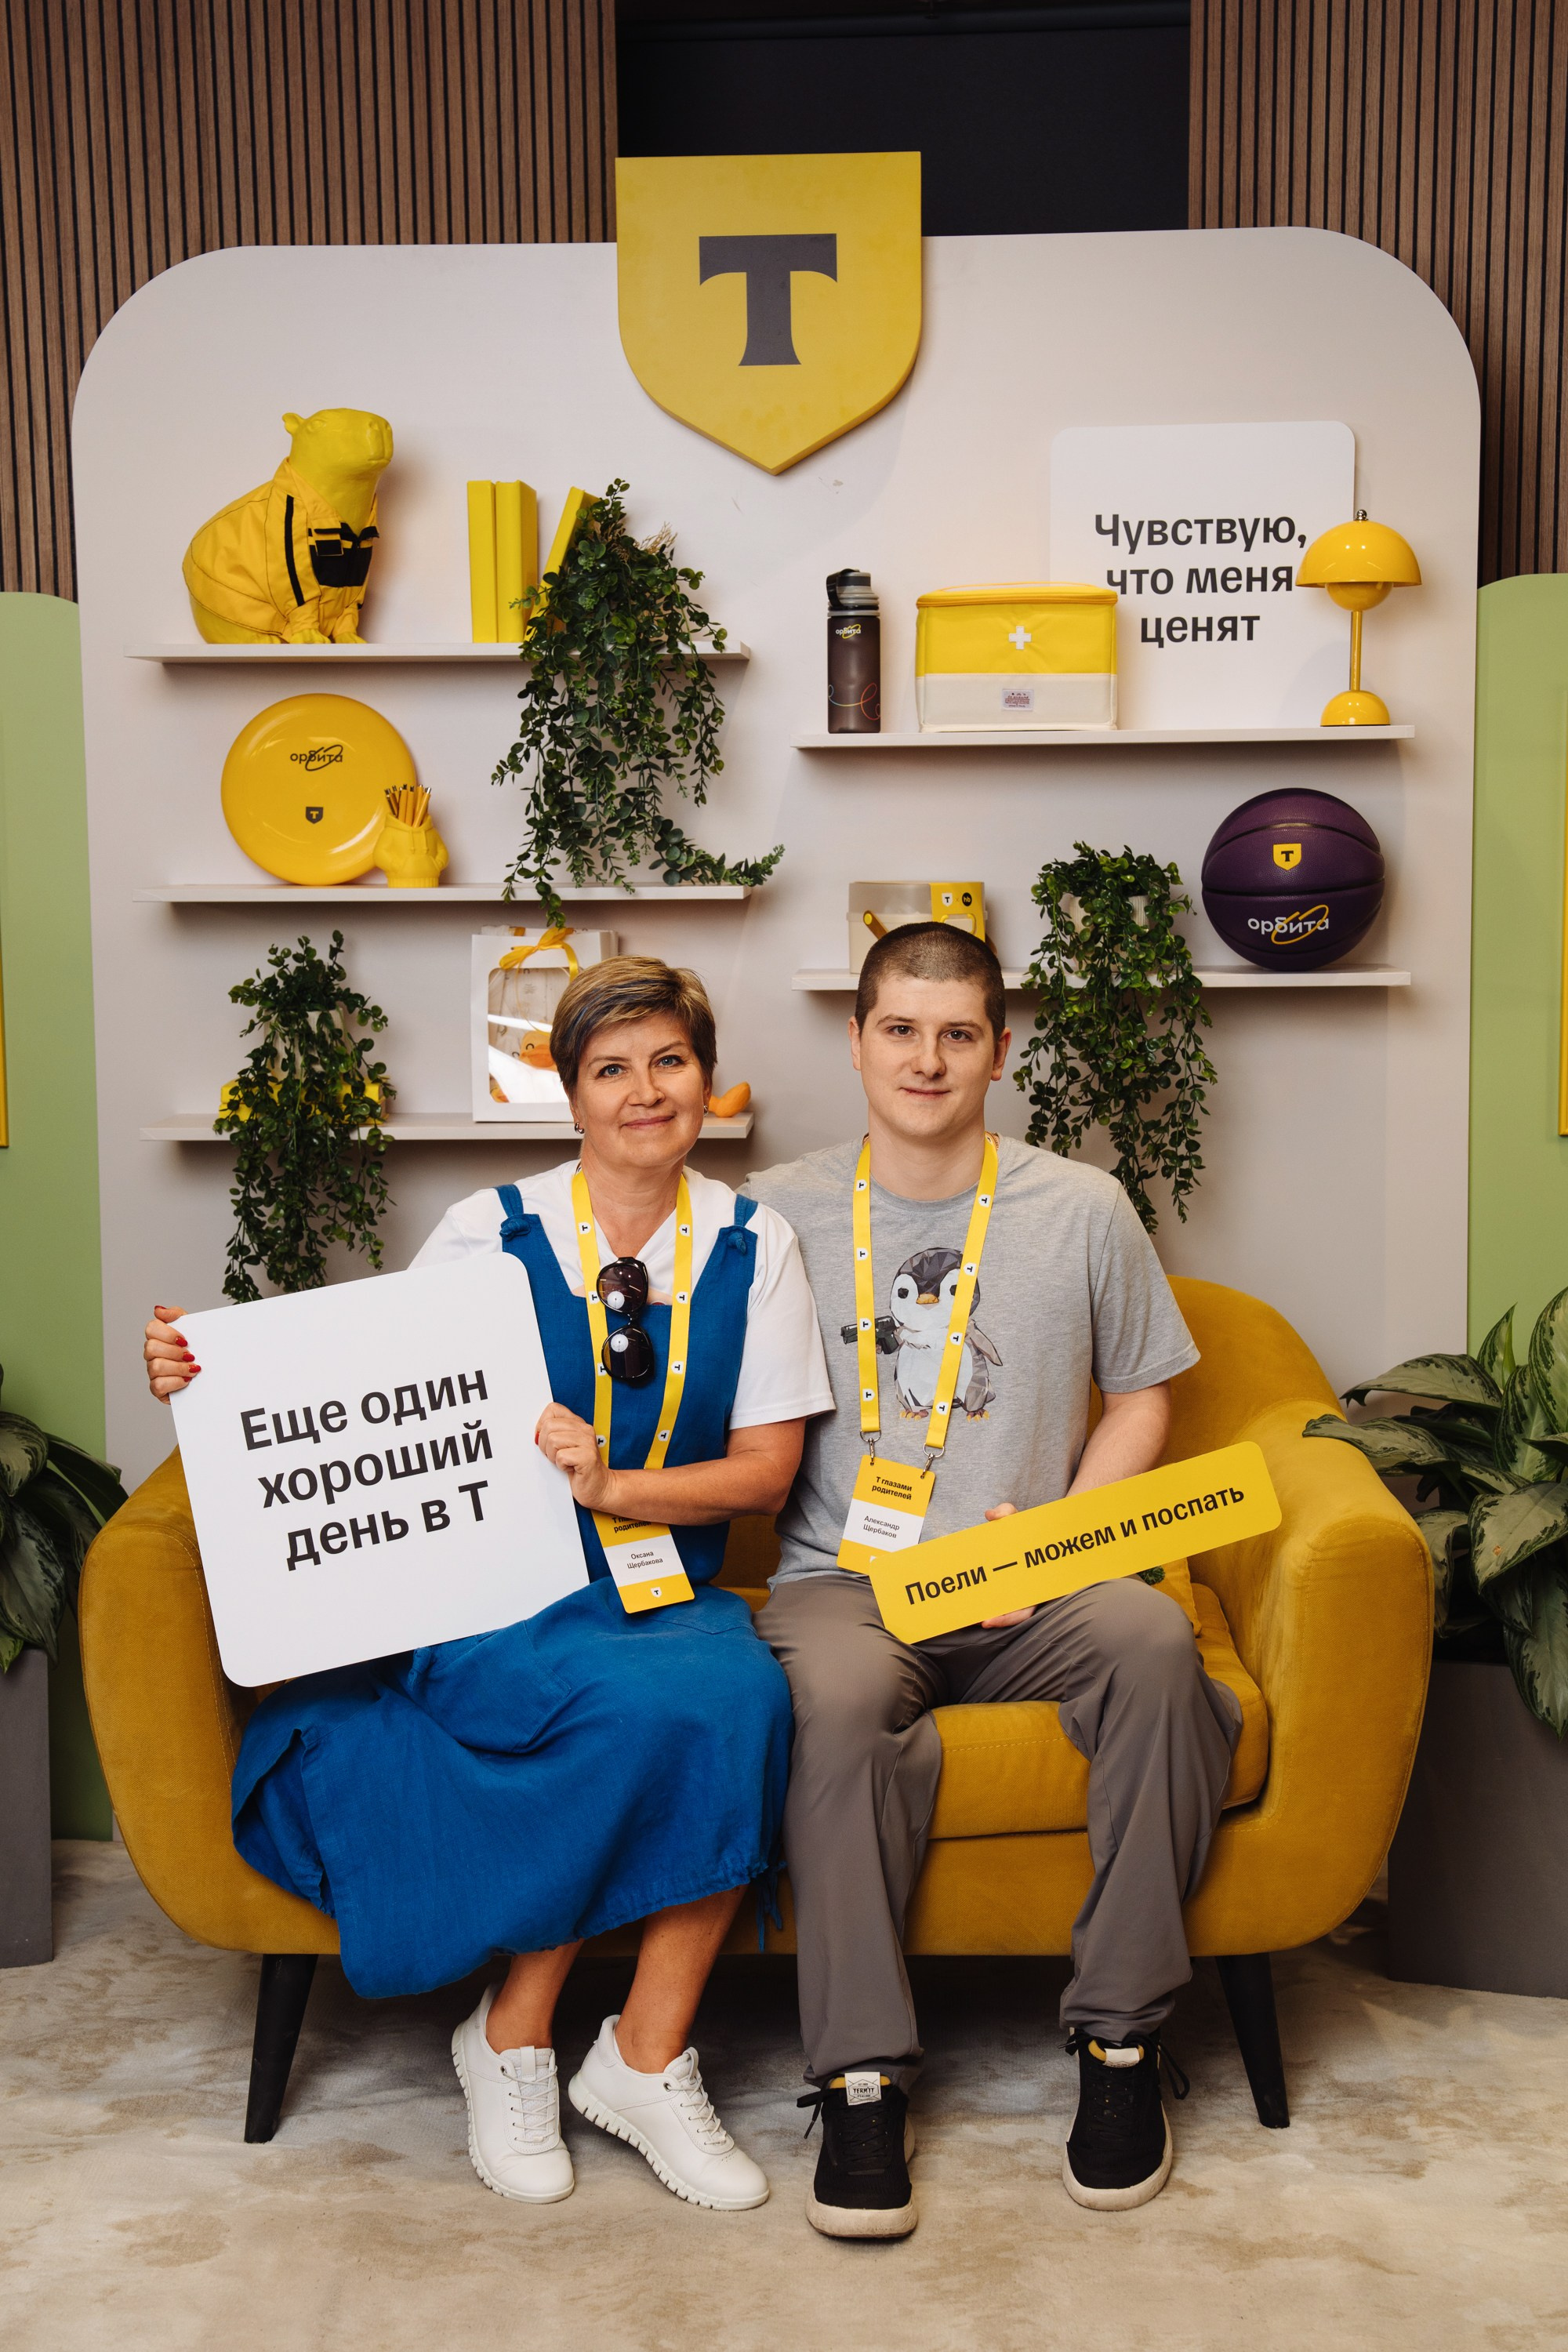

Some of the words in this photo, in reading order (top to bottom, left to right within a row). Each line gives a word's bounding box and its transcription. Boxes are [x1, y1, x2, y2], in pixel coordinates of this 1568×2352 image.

[699, 234, 837, 365] Т
[1095, 514, 1307, 554] Чувствую,
[1106, 568, 1174, 595] что
[1185, 565, 1293, 593] меня
[835, 626, 861, 637] орбита
[1141, 615, 1261, 648] ценят
[290, 749, 343, 766] орбита
[1247, 915, 1330, 937] орбита
[240, 1400, 348, 1451] Еще
[361, 1370, 488, 1427] один
[257, 1419, 493, 1508] хороший
[872, 1485, 912, 1500] родителей
[881, 1479, 912, 1491] глазами
[286, 1510, 409, 1572] день
[420, 1497, 451, 1534] в
[458, 1479, 489, 1523] Т
[863, 1523, 897, 1538] Щербаков
[864, 1515, 900, 1530] Александр
[905, 1566, 988, 1606] Поели
[1024, 1526, 1116, 1569] можем
[1120, 1519, 1138, 1538] и
[1141, 1486, 1245, 1531] поспать
[627, 1558, 663, 1570] Щербакова
